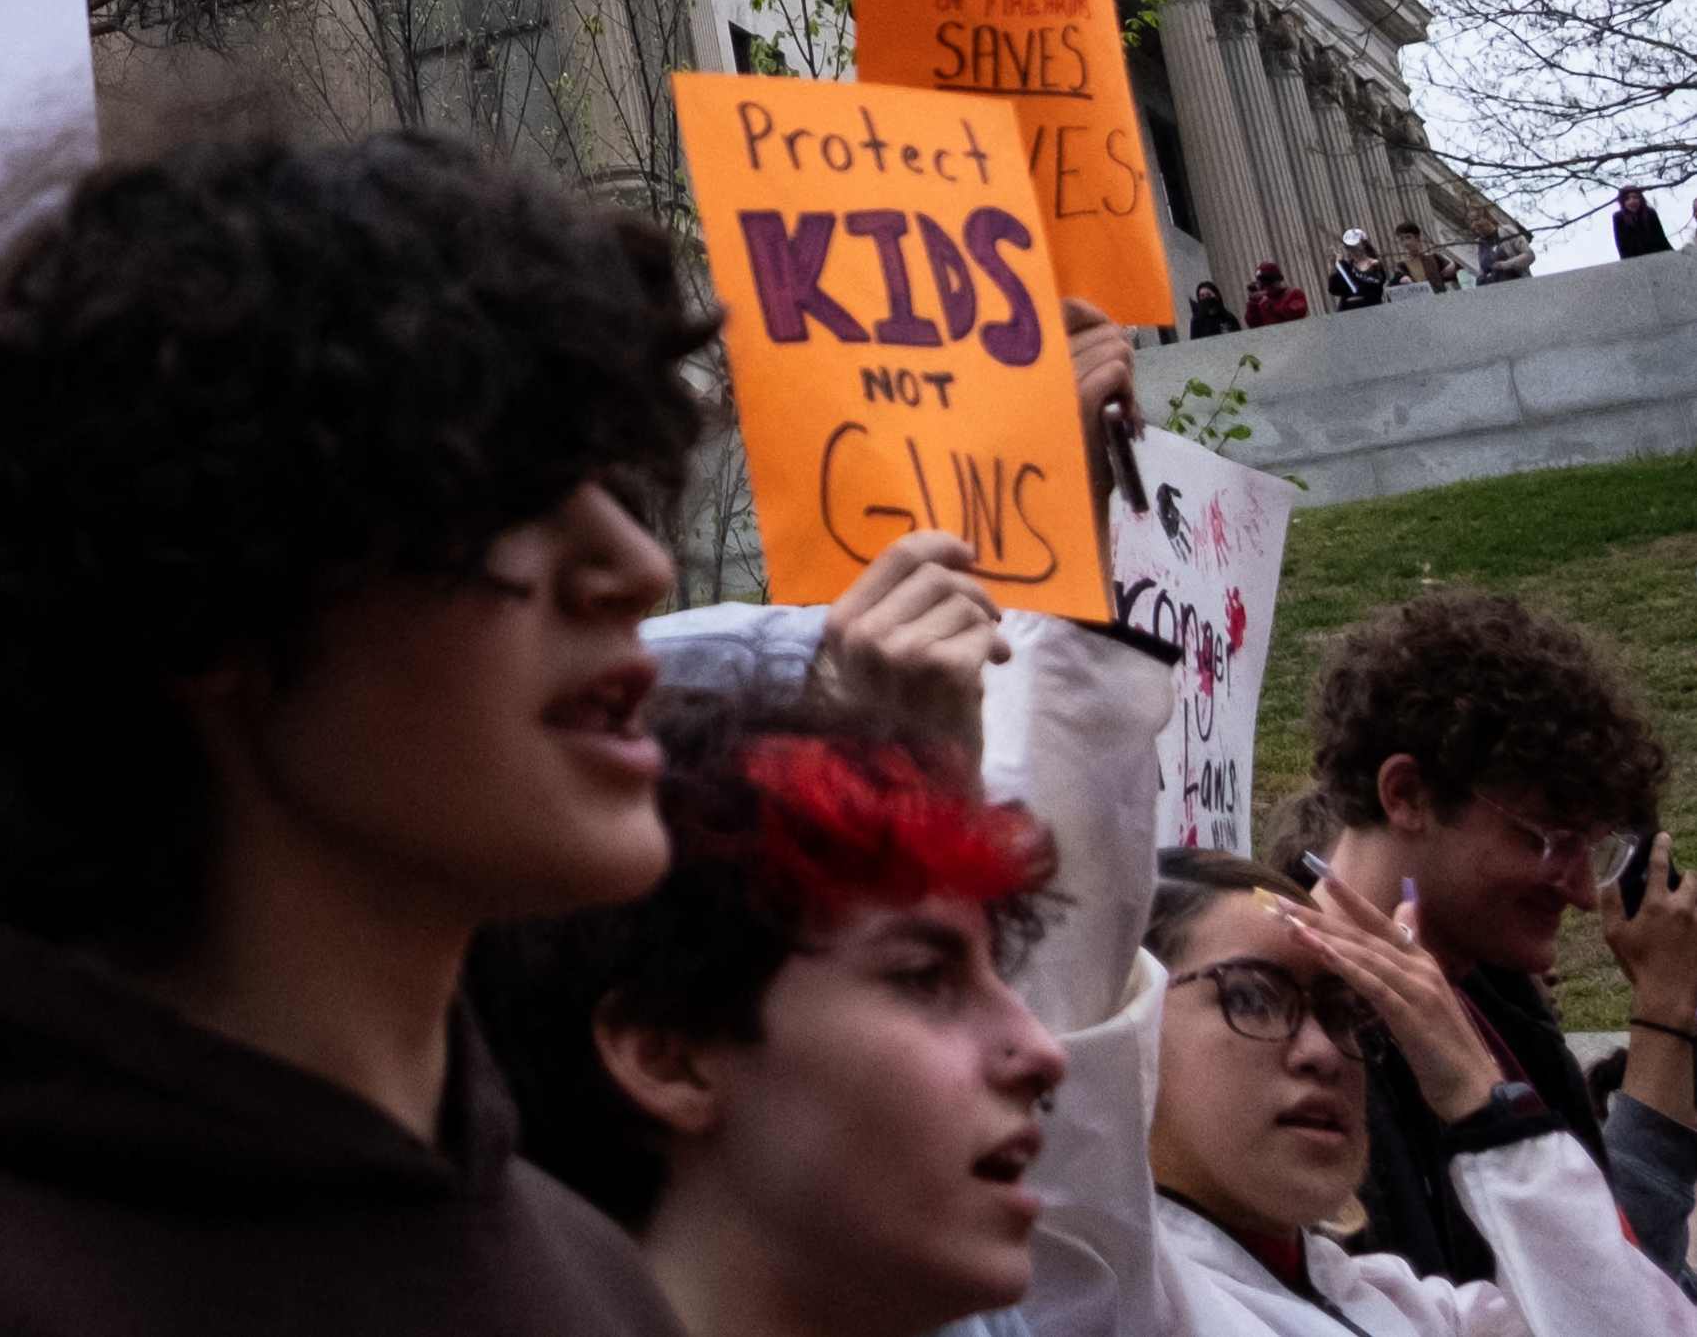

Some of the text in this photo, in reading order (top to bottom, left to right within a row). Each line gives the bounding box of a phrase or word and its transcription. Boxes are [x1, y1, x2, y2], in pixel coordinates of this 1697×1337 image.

[932, 20, 1089, 93] SAVES
[738, 100, 992, 186] Protect
[738, 206, 1044, 368] KIDS
[859, 366, 957, 411] NOT
[819, 421, 1059, 585] GUNS
